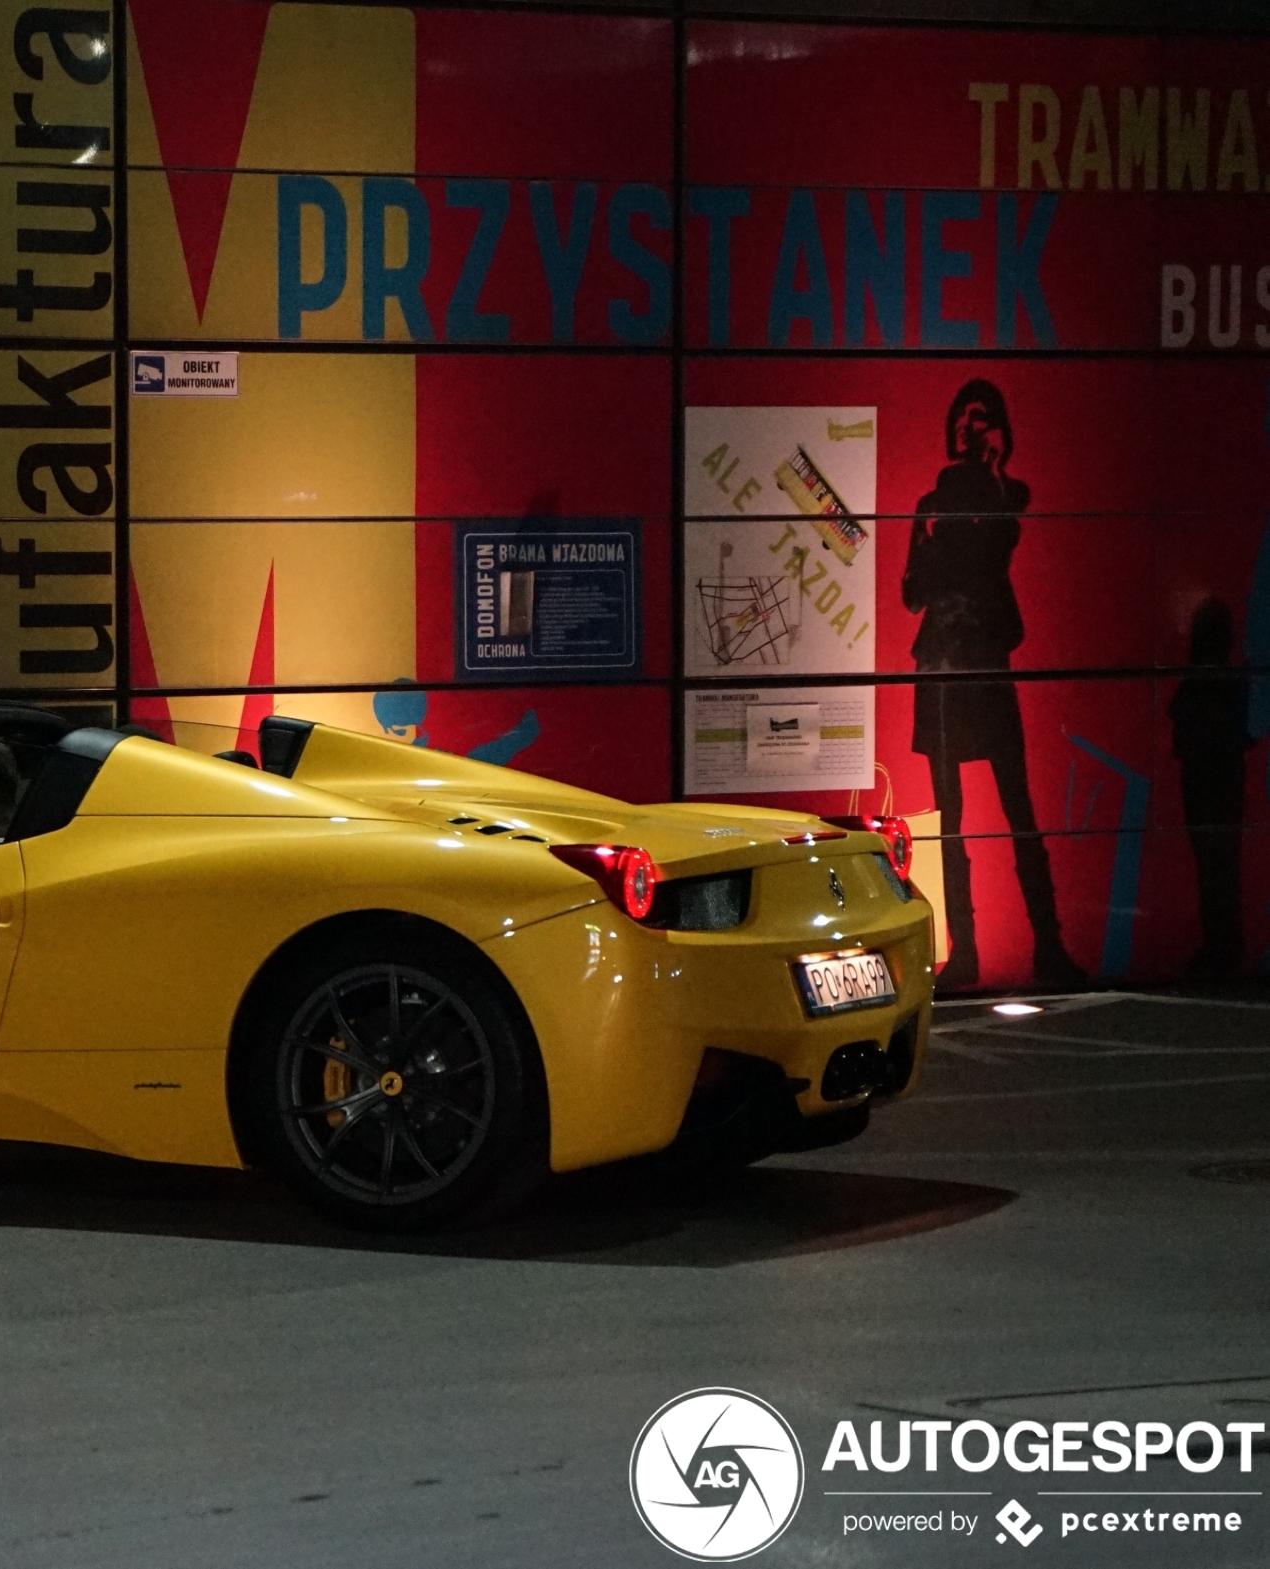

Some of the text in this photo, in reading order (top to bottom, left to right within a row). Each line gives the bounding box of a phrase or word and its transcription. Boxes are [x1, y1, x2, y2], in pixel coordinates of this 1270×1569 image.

[968, 82, 1270, 192] TRAMWA
[277, 174, 1060, 349] PRZYSTANEK
[167, 378, 236, 389] MONITOROWANY
[183, 361, 220, 373] OBIEKT
[701, 443, 763, 513] ALE
[499, 543, 625, 563] BRAMA WJAZDOWA
[769, 523, 870, 650] JAZDA!
[477, 544, 495, 638] DOMOFON
[477, 644, 526, 658] OCHRONA
